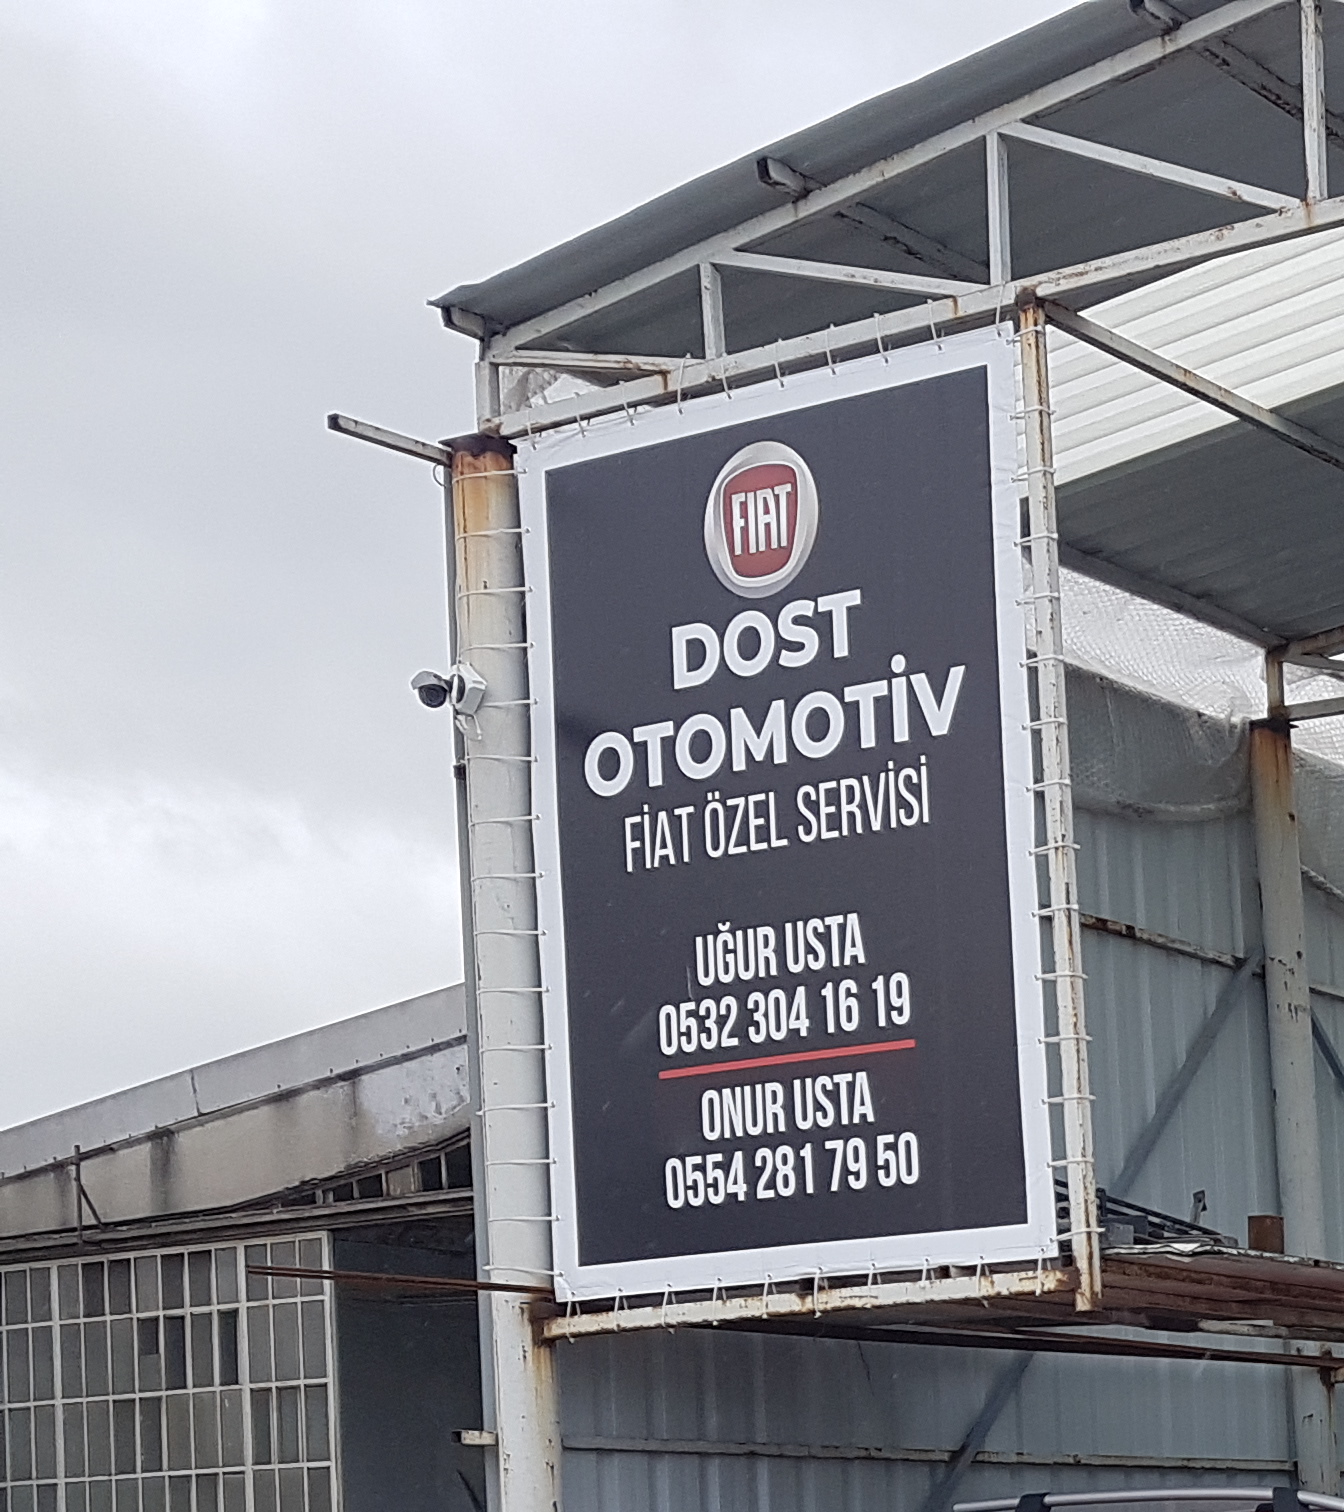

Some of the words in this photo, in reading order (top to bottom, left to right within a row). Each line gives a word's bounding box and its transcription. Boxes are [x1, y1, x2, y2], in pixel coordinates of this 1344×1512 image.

[731, 483, 792, 556] FIAT
[672, 589, 861, 690] DOST
[584, 654, 965, 797] OTOMOTİV
[624, 803, 695, 873] FİAT
[704, 791, 788, 859] ÖZEL
[797, 754, 930, 843] SERVİSİ
[695, 922, 778, 987] UĞUR
[785, 912, 867, 973] USTA
[658, 998, 740, 1057] 0532
[747, 985, 810, 1043] 304
[820, 979, 860, 1034] 16
[871, 972, 911, 1028] 19
[700, 1080, 786, 1142] ONUR
[793, 1071, 875, 1131] USTA
[664, 1150, 748, 1210] 0554
[753, 1142, 816, 1201] 281
[824, 1137, 868, 1192] 79
[876, 1131, 920, 1186] 50
